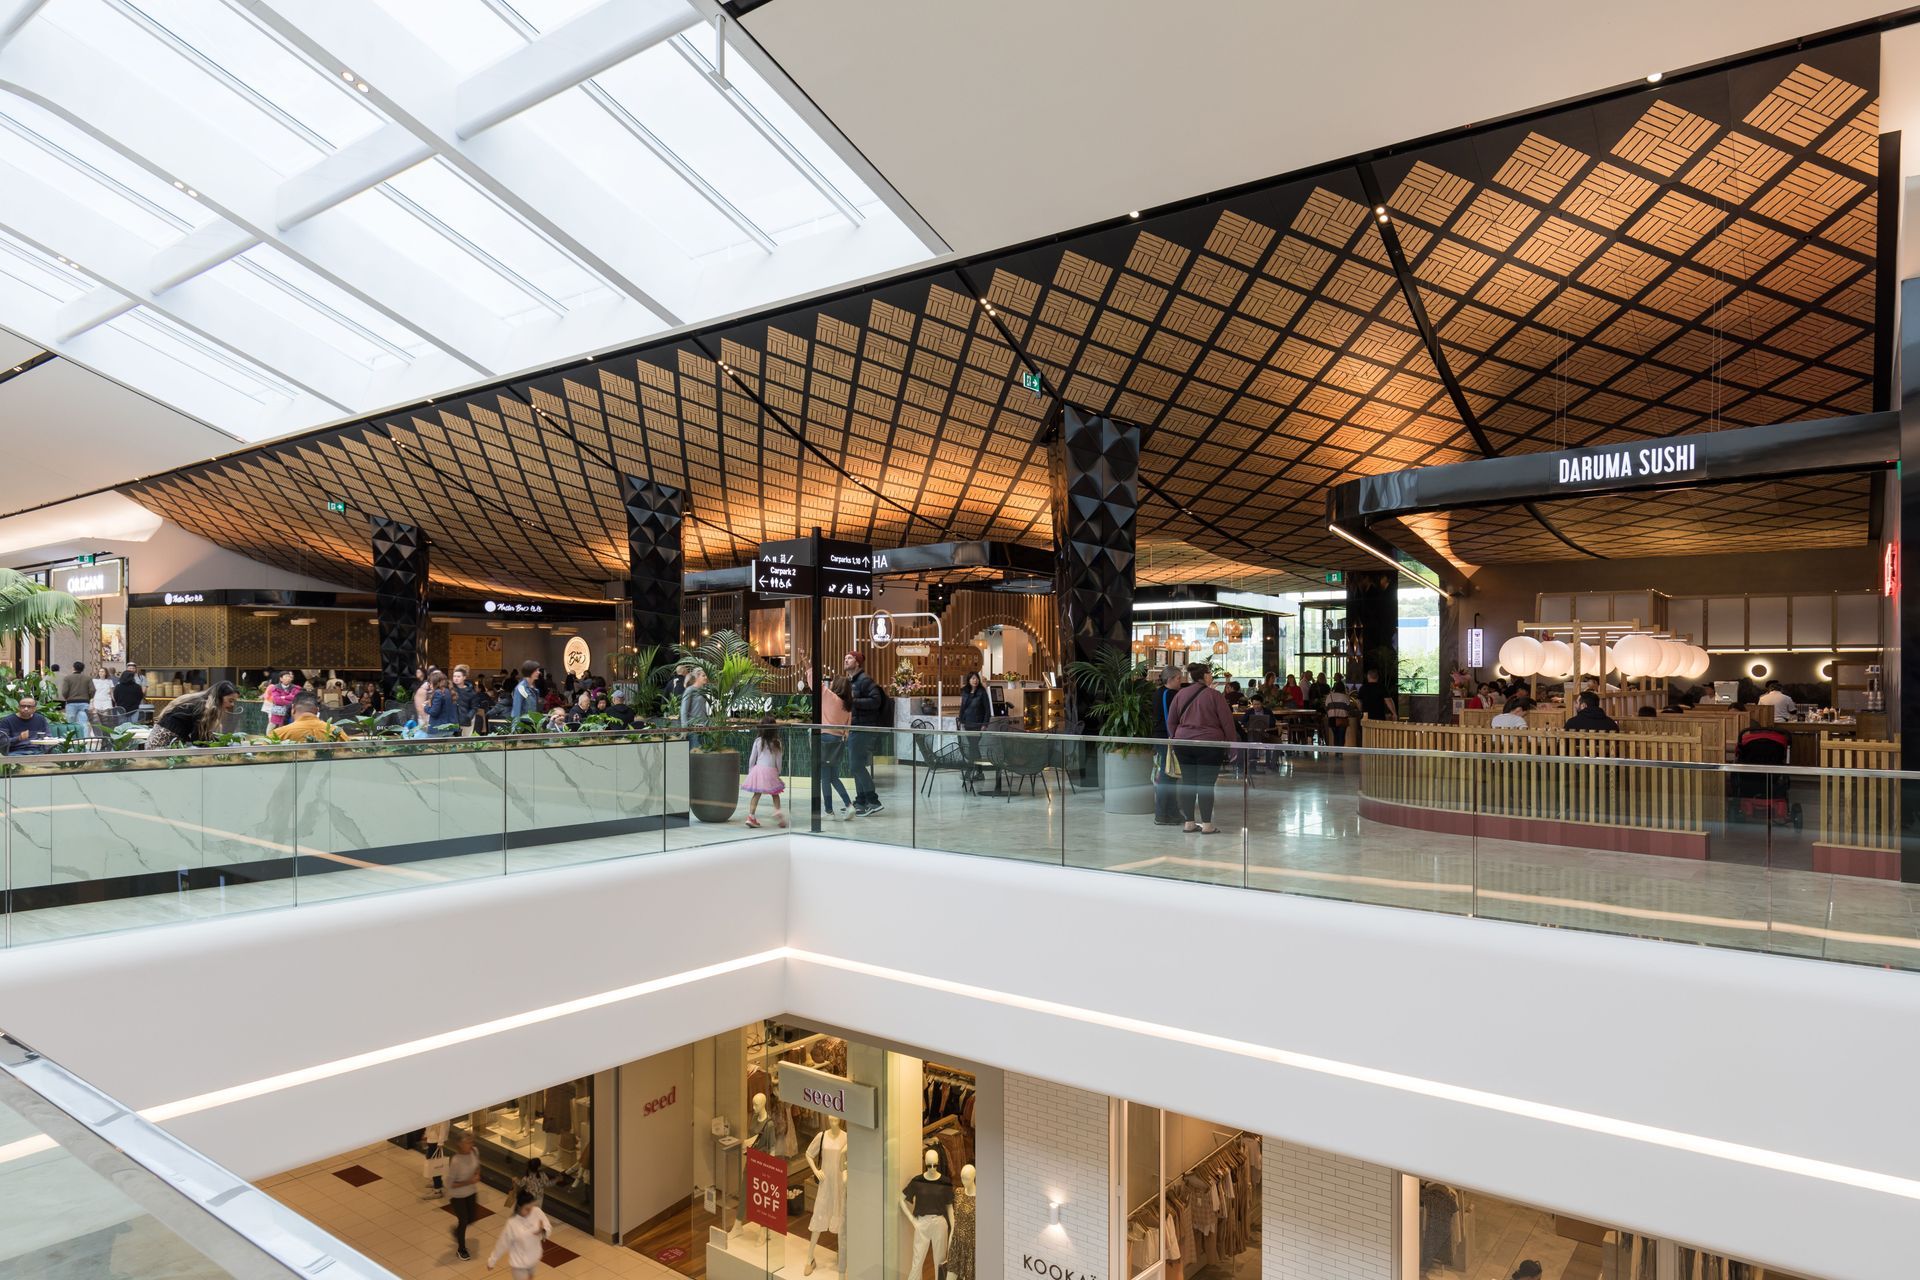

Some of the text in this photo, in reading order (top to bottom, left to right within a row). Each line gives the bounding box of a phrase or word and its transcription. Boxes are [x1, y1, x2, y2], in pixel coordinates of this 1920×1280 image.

[1559, 444, 1696, 484] DARUMA SUSHI
[830, 554, 851, 564] Carparks
[872, 554, 889, 569] HA
[770, 566, 797, 576] Carpark 2
[643, 1086, 676, 1117] seed
[803, 1087, 845, 1112] seed
[753, 1176, 780, 1199] 50%
[753, 1192, 780, 1212] OFF
